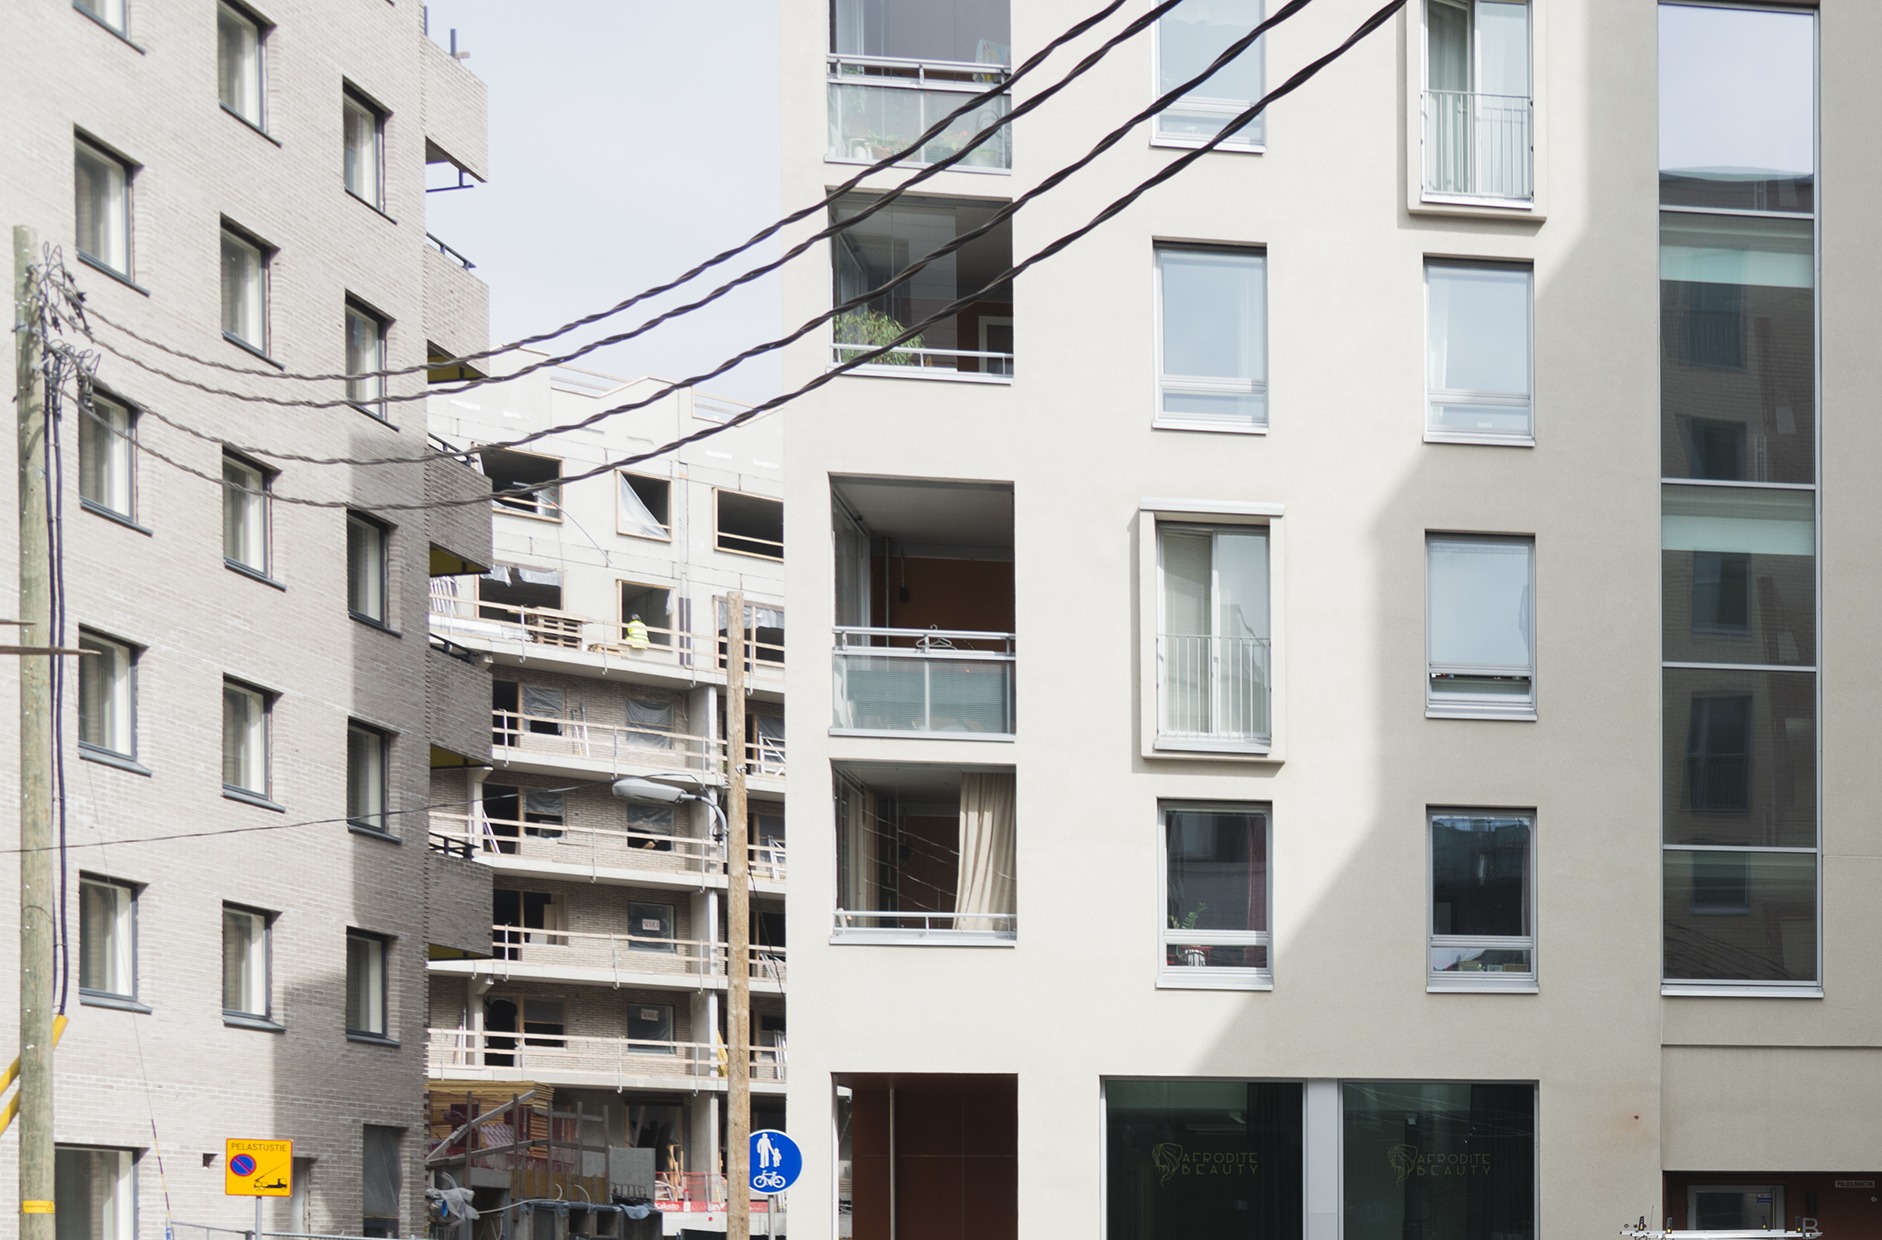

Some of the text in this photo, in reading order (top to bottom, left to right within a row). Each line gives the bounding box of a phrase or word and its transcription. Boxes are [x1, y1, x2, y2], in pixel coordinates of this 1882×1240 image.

[231, 1142, 288, 1152] PELASTUSTIE
[1182, 1152, 1258, 1164] AFRODITE
[1417, 1153, 1491, 1165] AFRODITE
[1182, 1164, 1258, 1175] BEAUTY
[1417, 1165, 1490, 1176] BEAUTY
